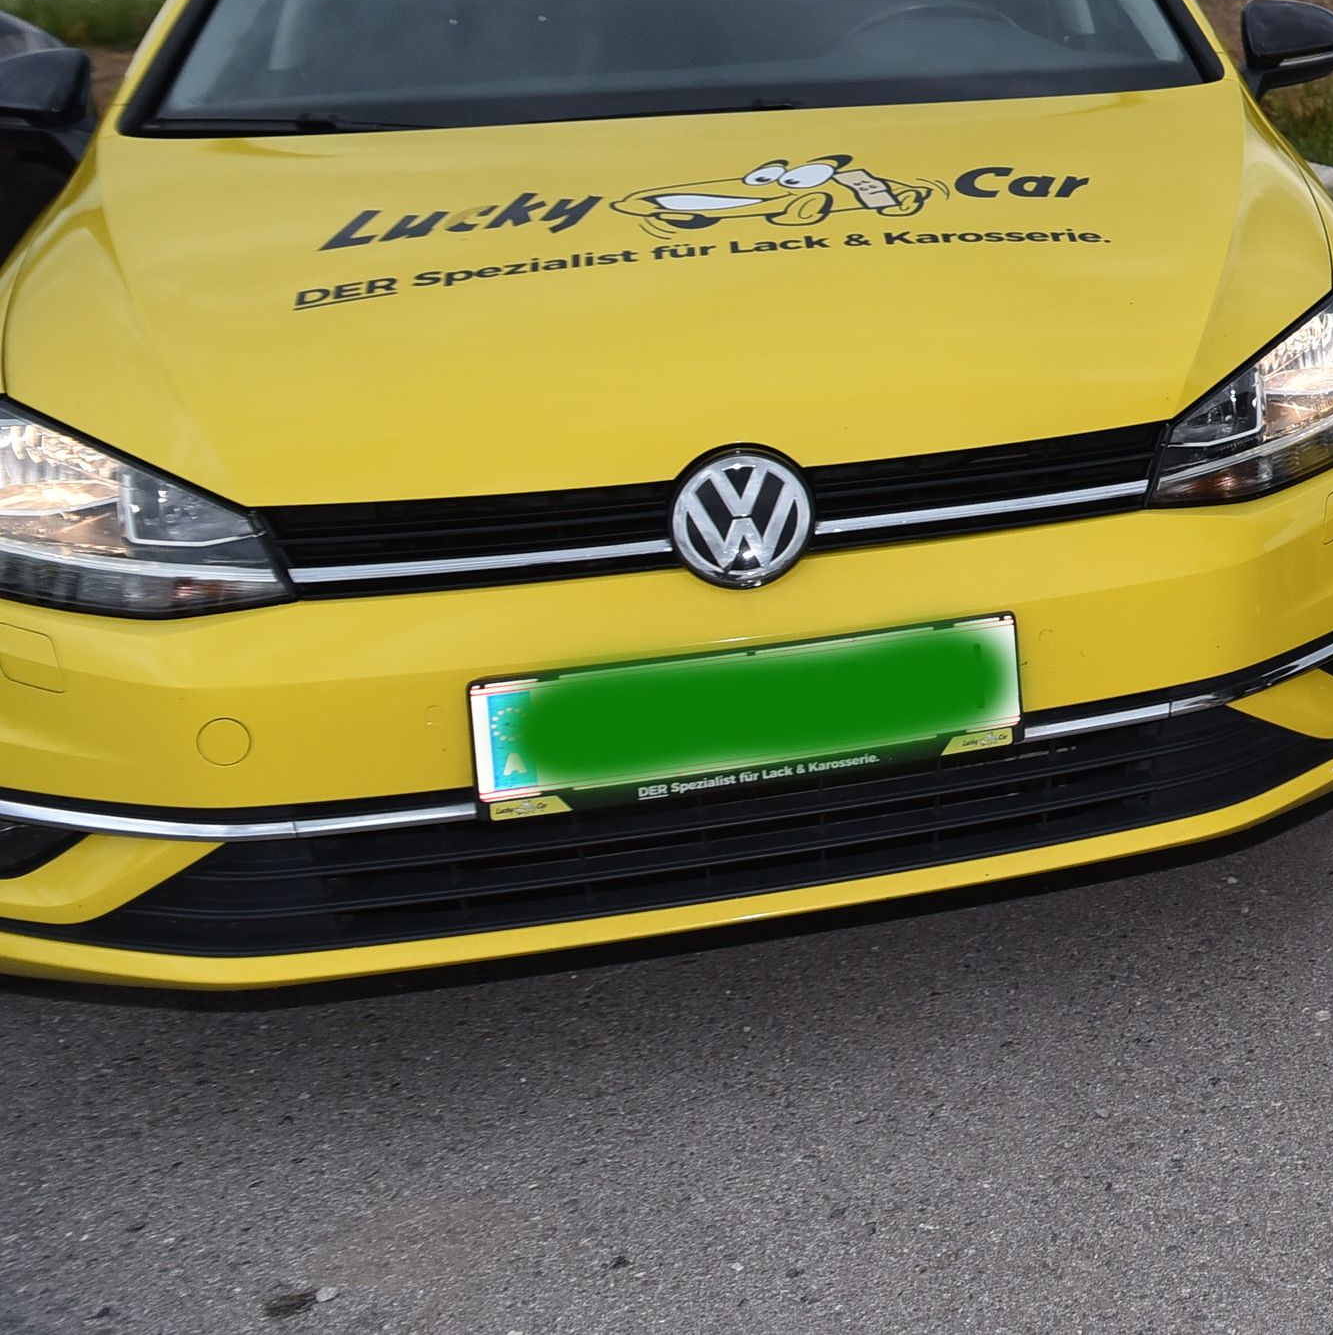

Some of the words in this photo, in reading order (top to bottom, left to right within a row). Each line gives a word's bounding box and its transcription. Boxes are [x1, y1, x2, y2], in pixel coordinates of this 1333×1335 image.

[316, 192, 604, 251] Lucky
[955, 166, 1090, 198] Car
[293, 276, 398, 309] DER
[411, 250, 639, 287] Spezialist
[652, 243, 716, 261] für
[729, 235, 831, 255] Lack
[843, 233, 872, 248] &
[884, 228, 1112, 246] Karosserie.
[503, 752, 528, 776] A
[637, 783, 670, 799] DER
[671, 774, 736, 794] Spezialist
[739, 770, 759, 784] für
[762, 765, 793, 780] Lack
[796, 763, 806, 774] &
[808, 753, 881, 773] Karosserie.
